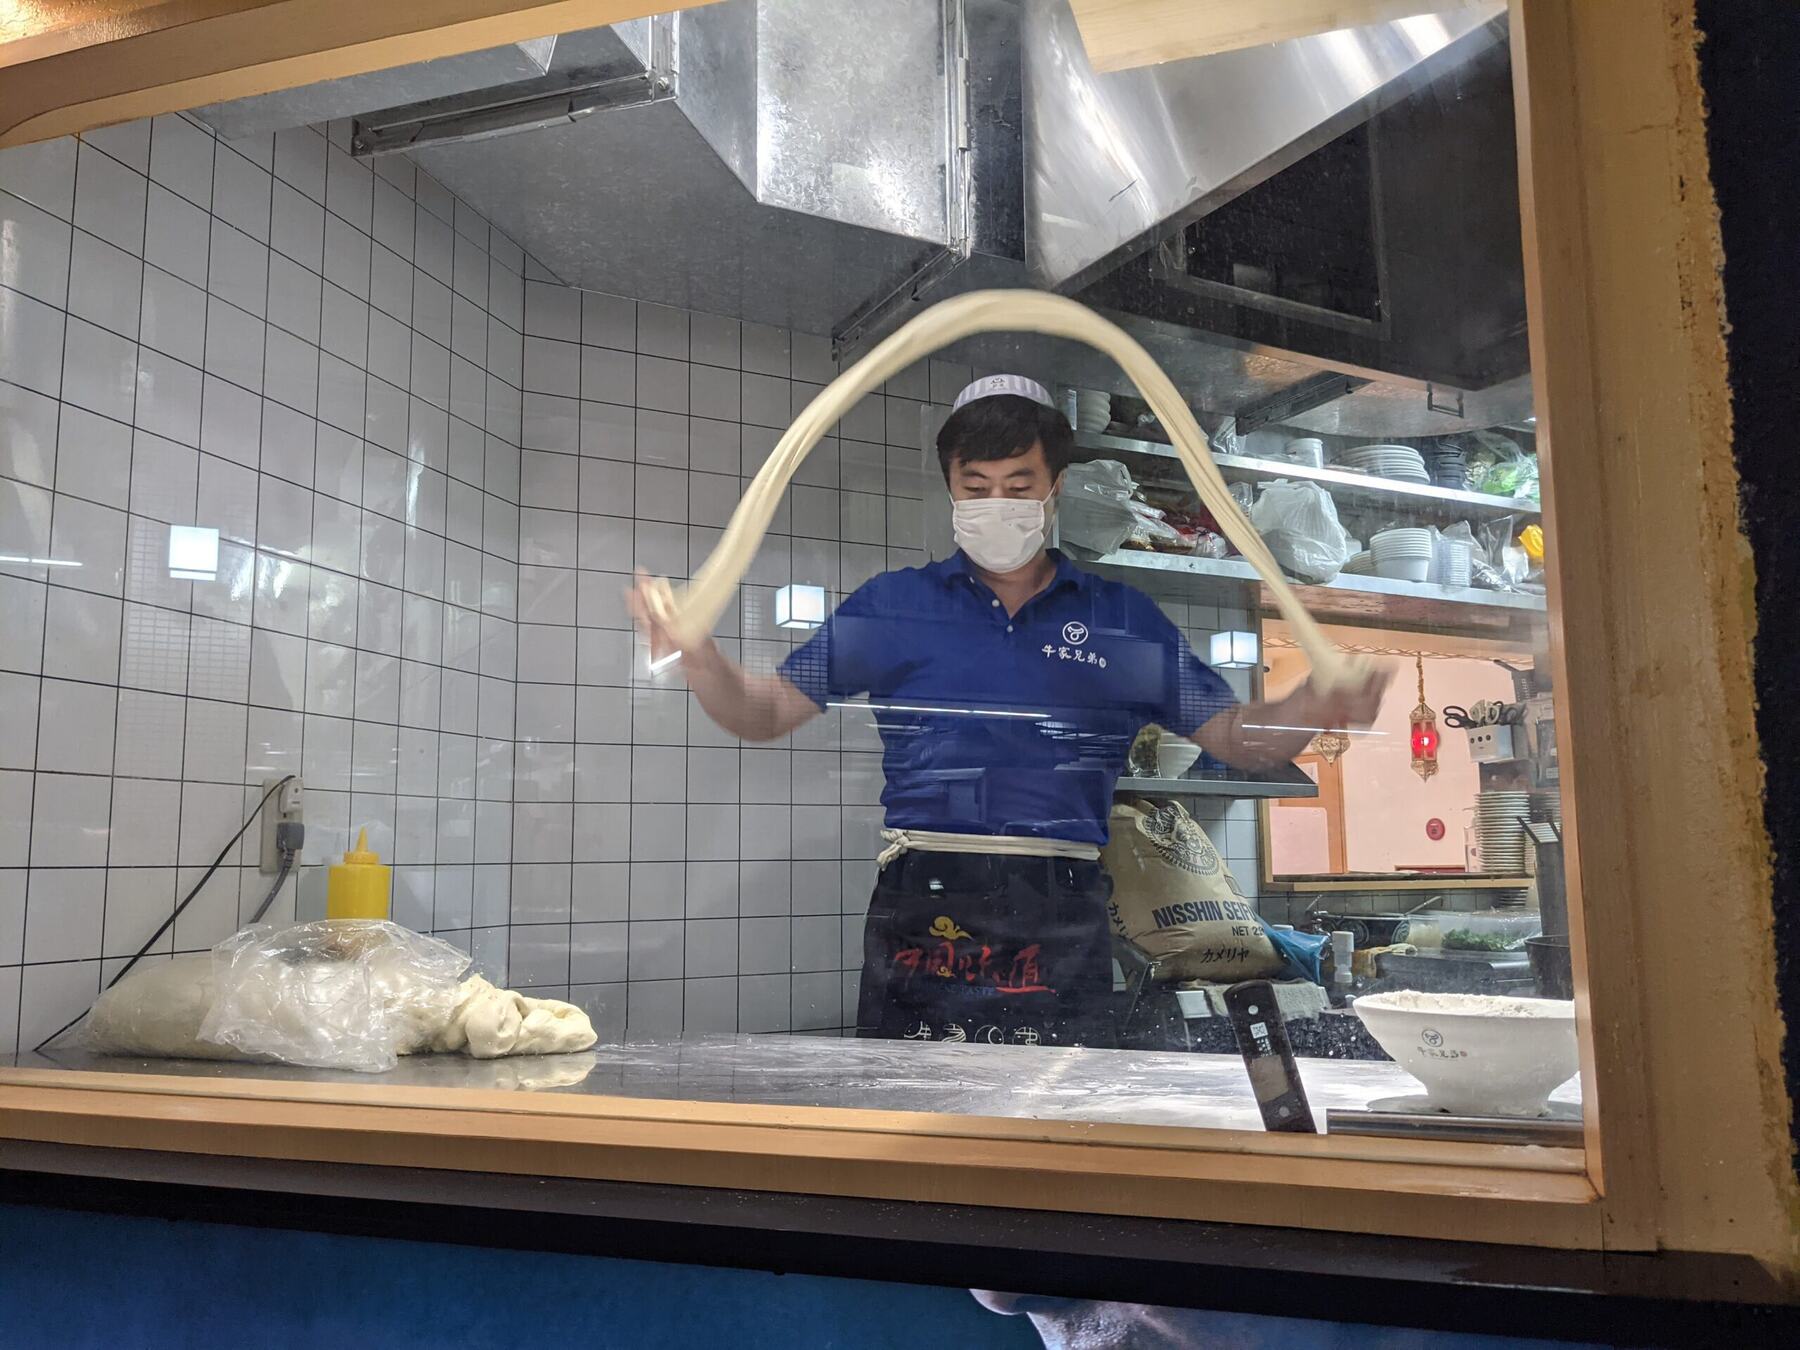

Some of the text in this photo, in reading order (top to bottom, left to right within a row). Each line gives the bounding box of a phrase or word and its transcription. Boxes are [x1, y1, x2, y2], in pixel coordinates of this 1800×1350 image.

[1042, 644, 1098, 664] 牛家兄弟
[1152, 901, 1223, 928] NISSHIN
[1232, 926, 1249, 936] NET
[1200, 945, 1250, 963] カメリヤ
